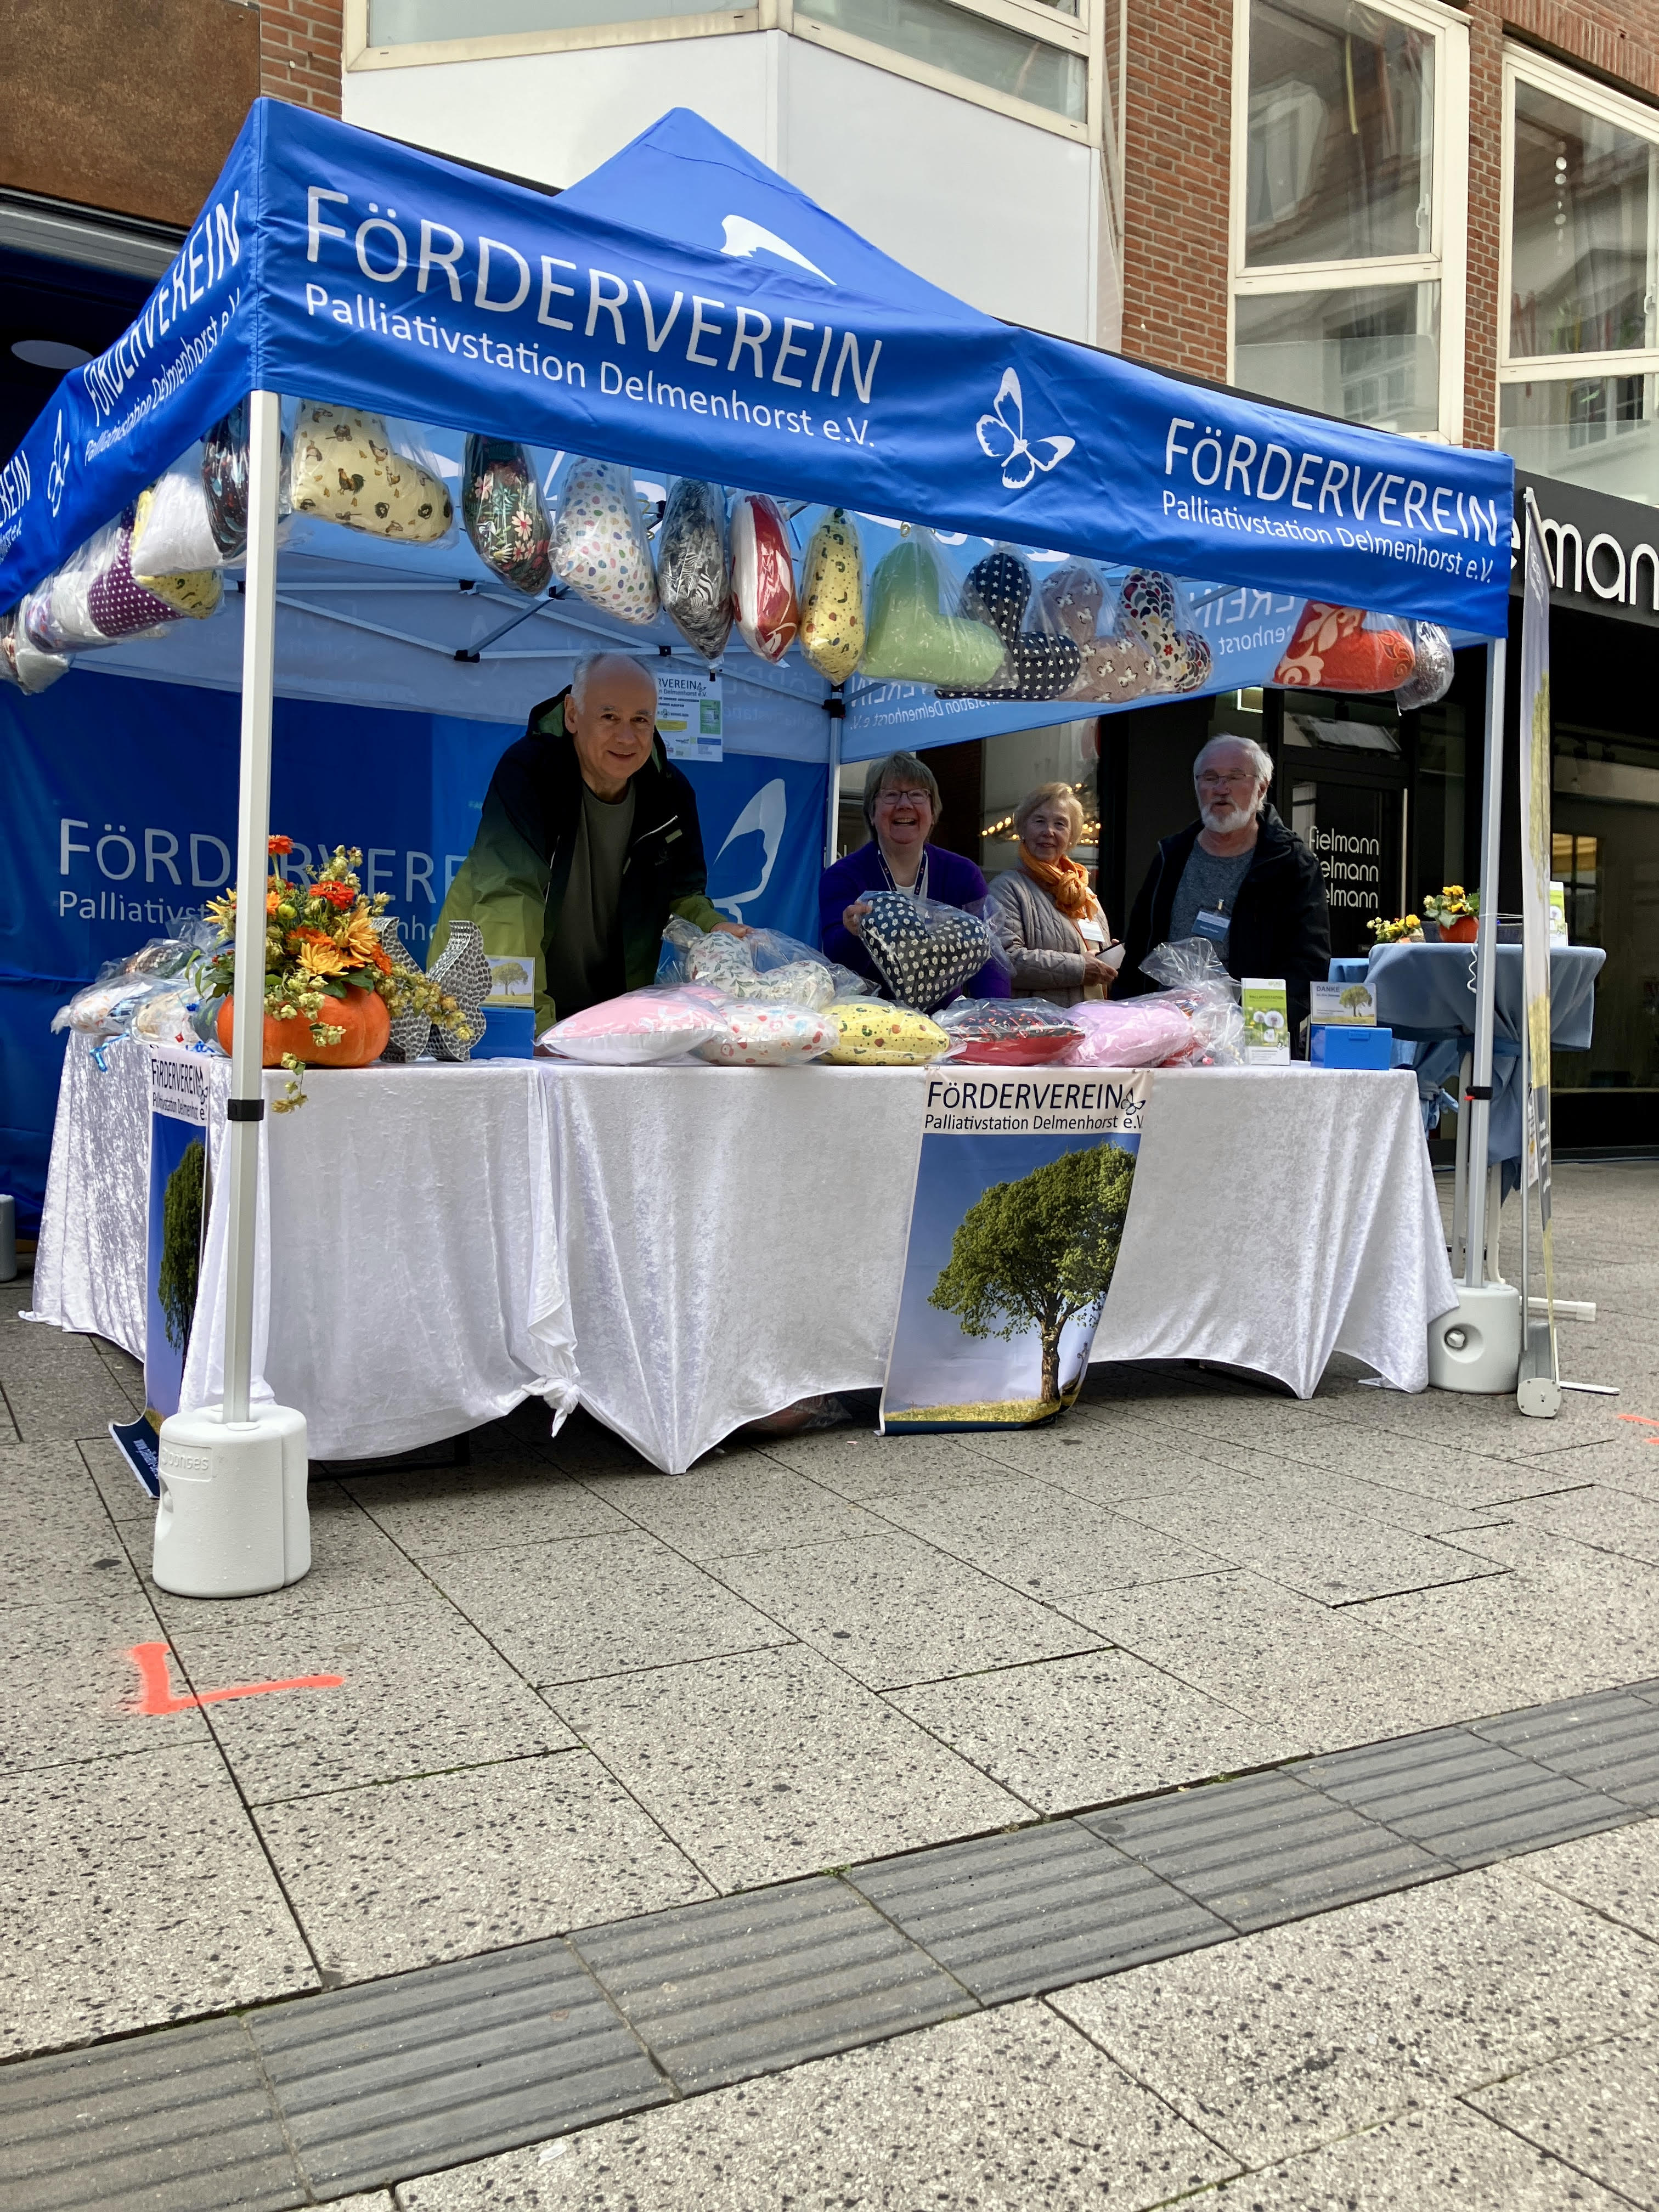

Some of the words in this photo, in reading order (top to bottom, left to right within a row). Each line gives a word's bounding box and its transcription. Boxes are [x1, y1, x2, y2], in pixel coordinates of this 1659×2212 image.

[307, 186, 882, 404] FÖRDERVEREIN
[306, 283, 585, 388] Palliativstation
[600, 361, 814, 437] Delmenhorst
[823, 417, 875, 447] e.V.
[1165, 417, 1498, 546] FÖRDERVEREIN
[1163, 490, 1334, 545] Palliativstation
[1336, 526, 1463, 575] Delmenhorst
[1465, 557, 1492, 583] e.V.
[1309, 825, 1379, 855] fielmann
[1319, 855, 1379, 882] elmann
[924, 1114, 1029, 1130] Palliativstation
[1033, 1114, 1118, 1130] Delmenhorst
[927, 1081, 1123, 1109] FÖRDERVEREIN
